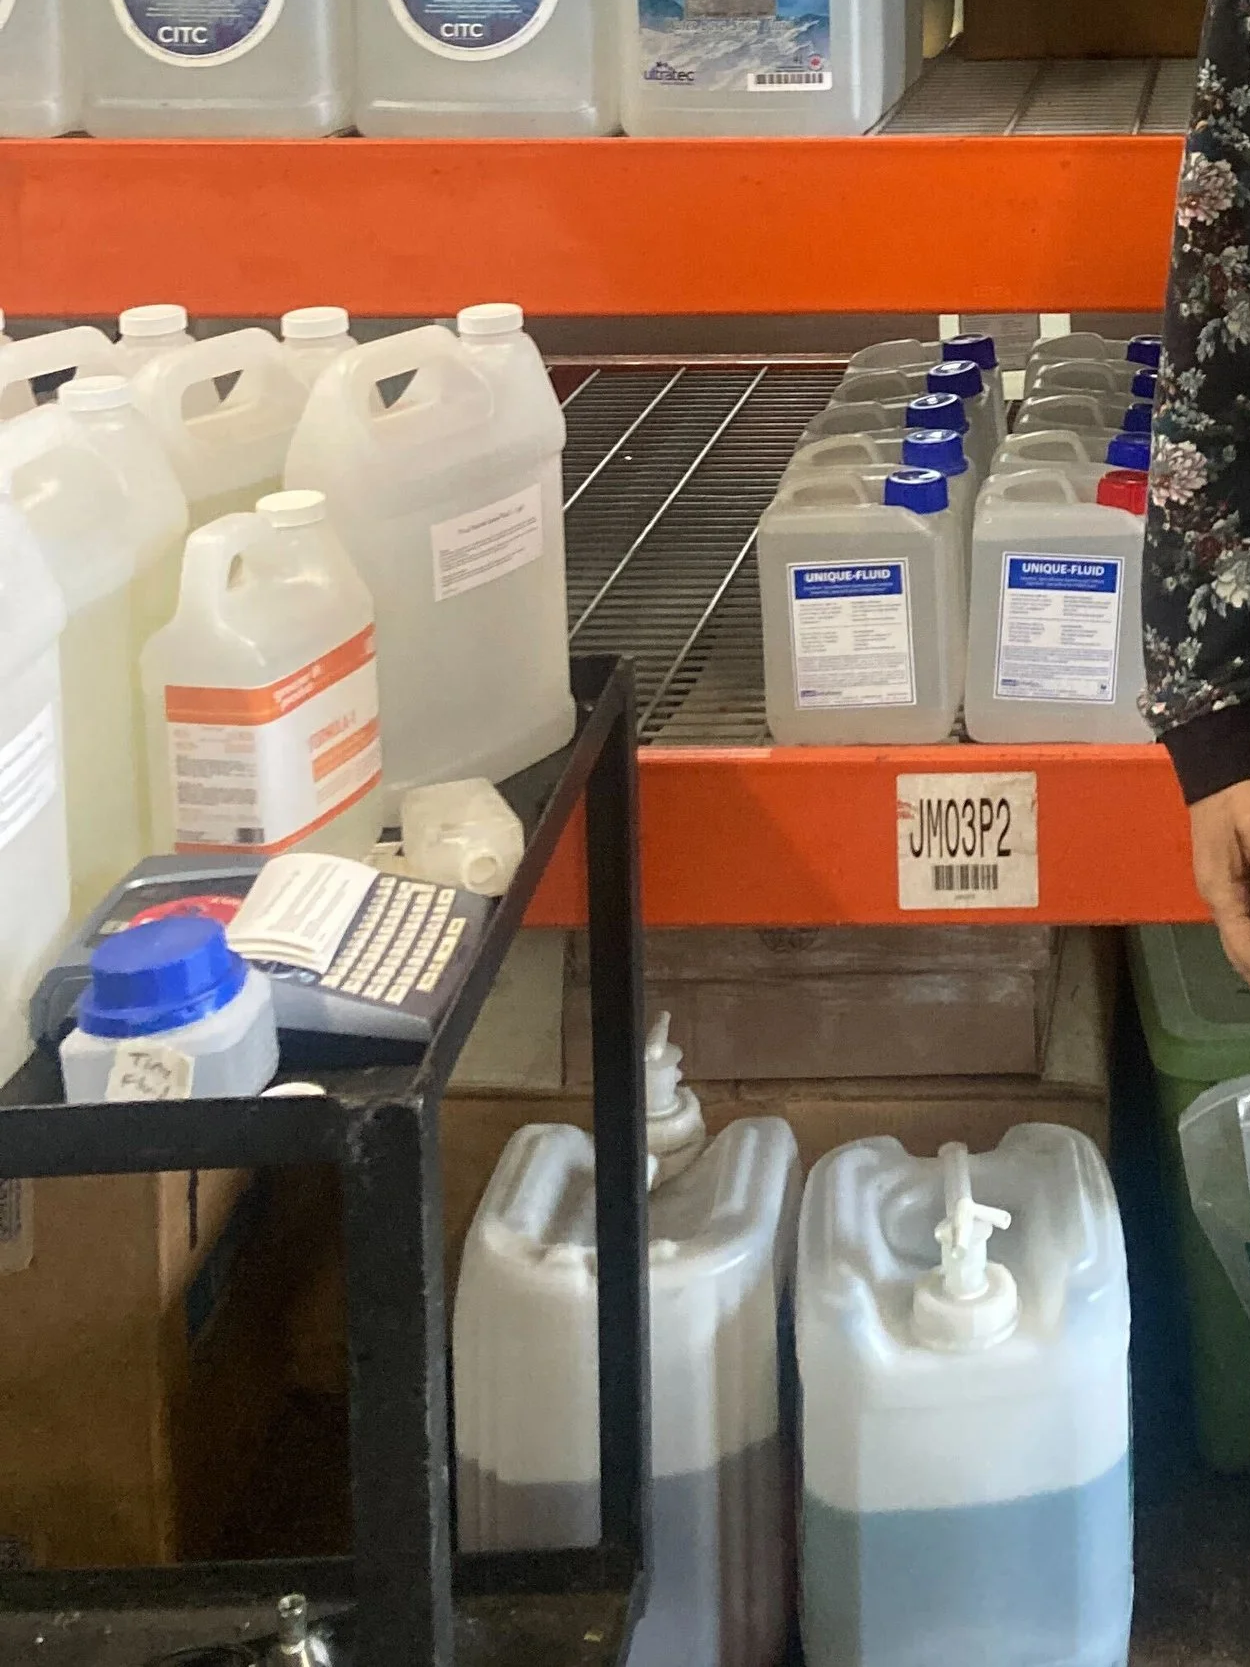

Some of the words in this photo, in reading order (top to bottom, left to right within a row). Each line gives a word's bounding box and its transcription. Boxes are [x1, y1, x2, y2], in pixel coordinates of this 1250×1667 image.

[157, 26, 209, 44] CITC
[440, 22, 484, 38] CITC
[643, 64, 696, 82] ultratec
[804, 568, 892, 584] UNIQUE-FLUID
[1021, 562, 1106, 577] UNIQUE-FLUID
